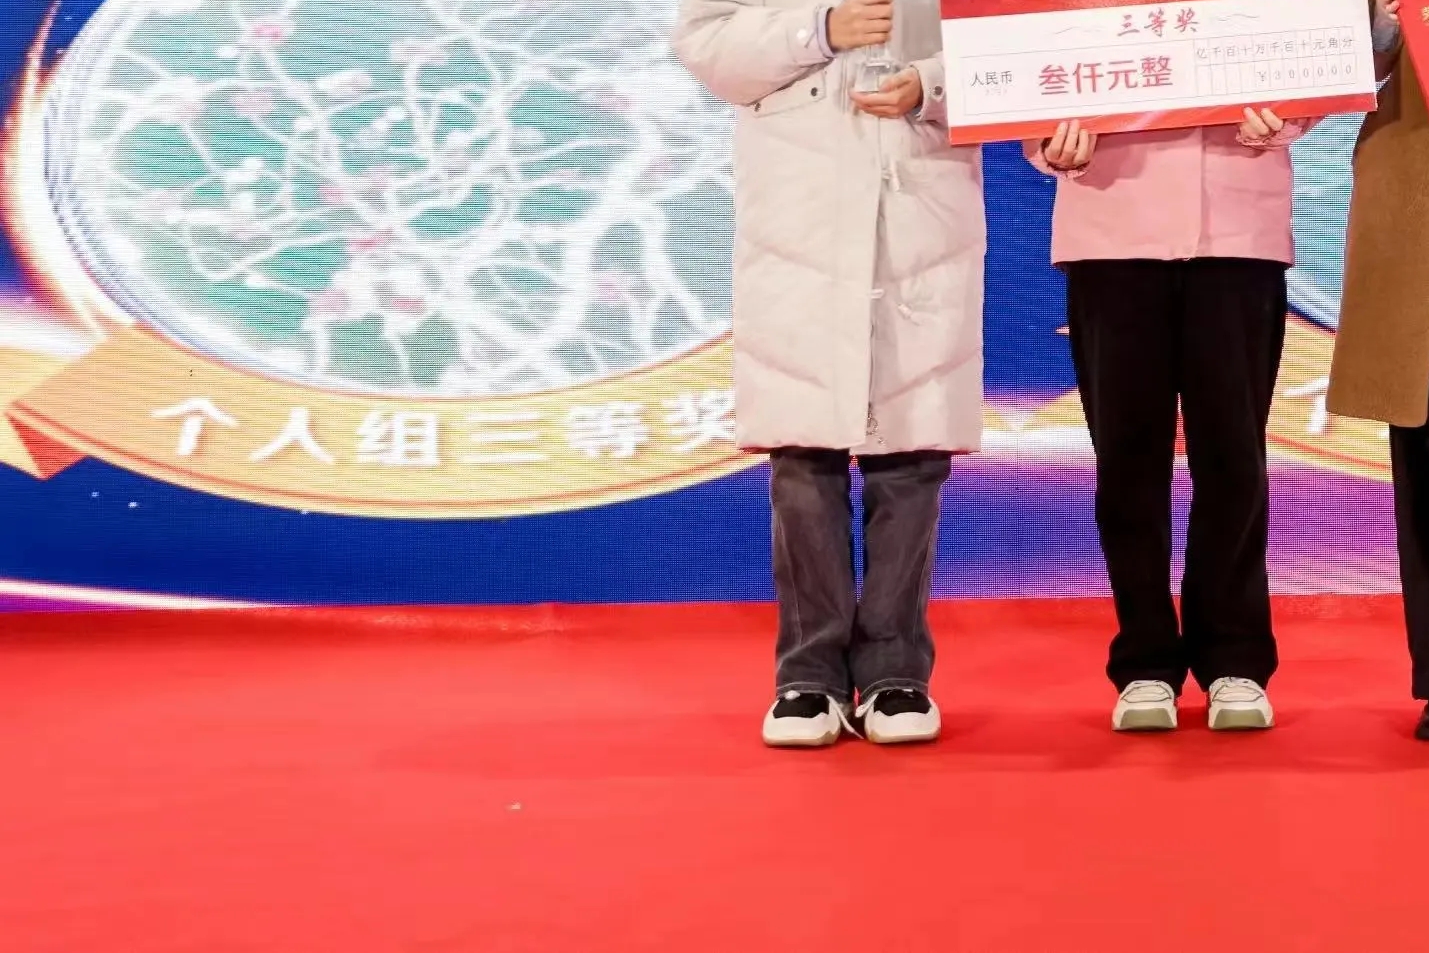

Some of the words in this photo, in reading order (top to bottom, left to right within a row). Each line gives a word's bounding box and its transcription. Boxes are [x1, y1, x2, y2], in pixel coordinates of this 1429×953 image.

[1117, 7, 1200, 38] 三等奖
[970, 70, 1013, 87] 人民币
[1038, 54, 1173, 96] 叁仟元整
[153, 389, 736, 467] 个人组三等奖
